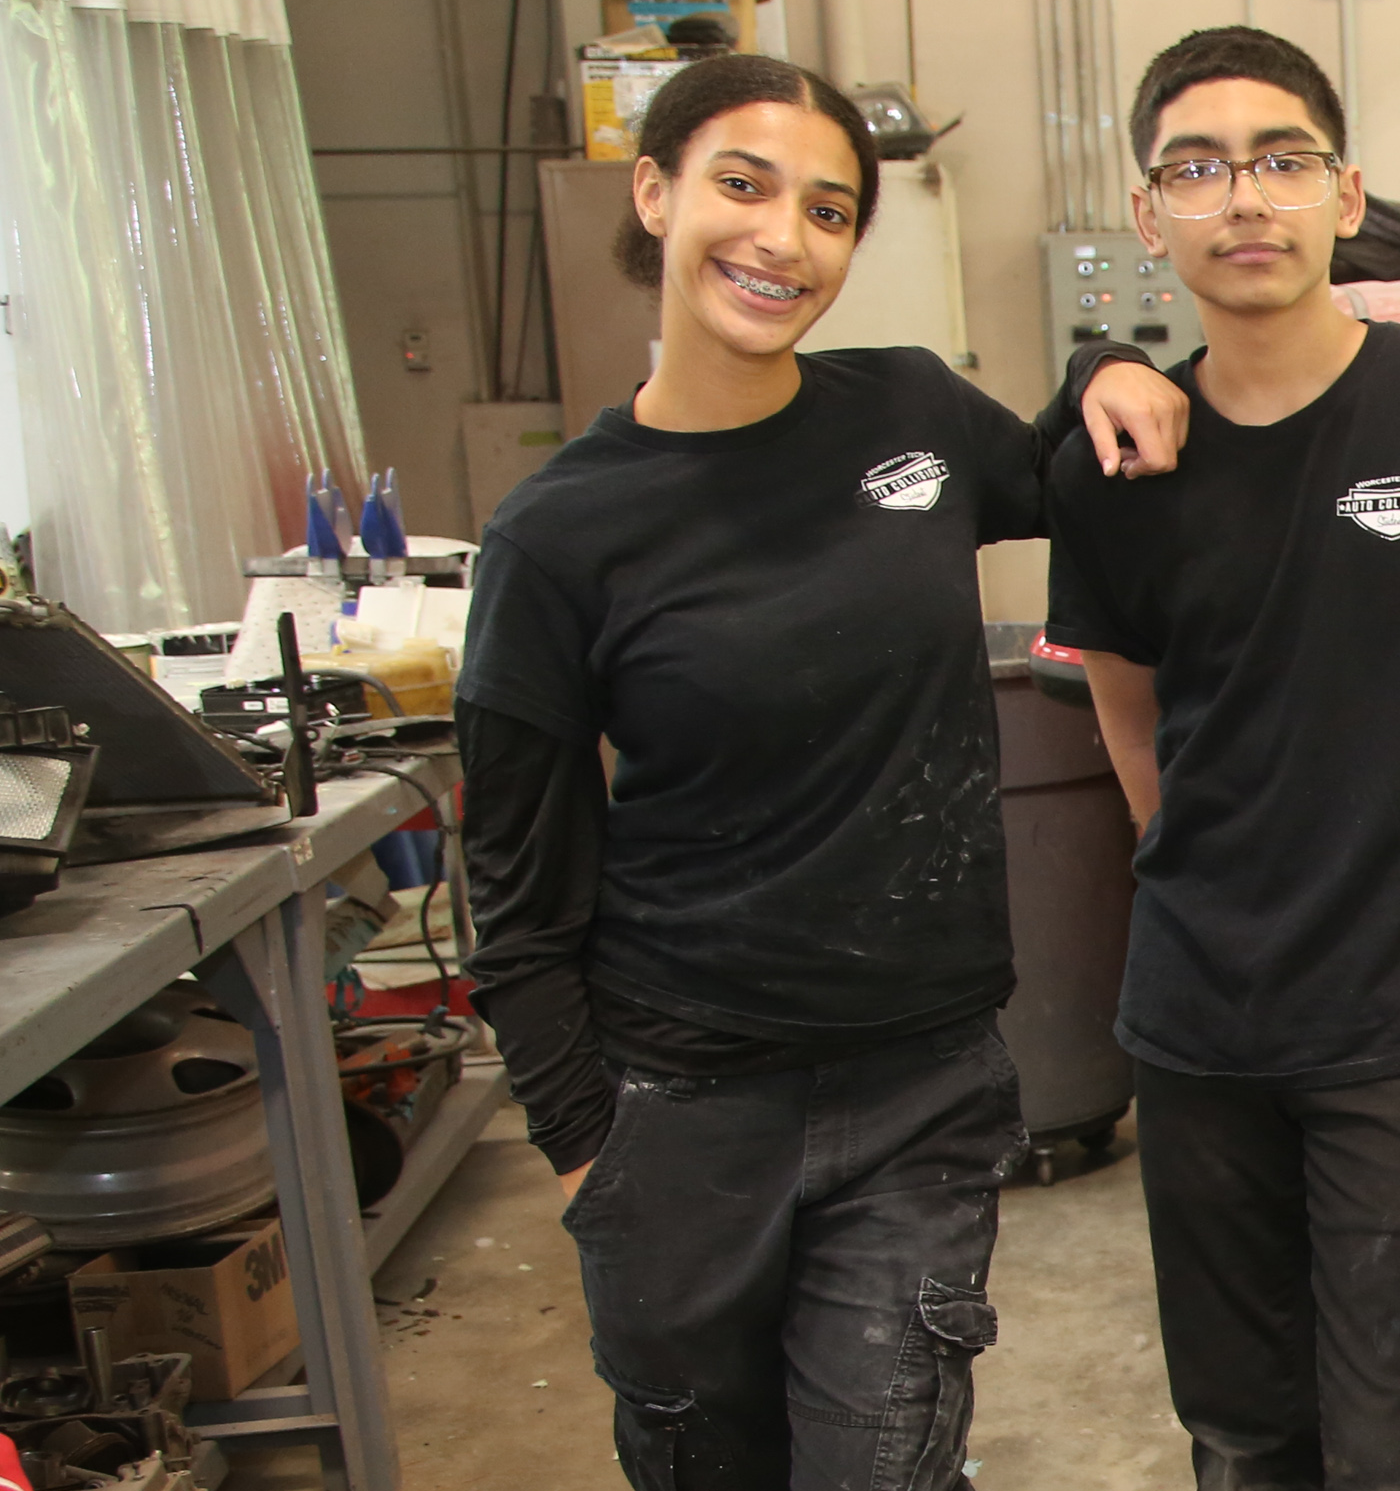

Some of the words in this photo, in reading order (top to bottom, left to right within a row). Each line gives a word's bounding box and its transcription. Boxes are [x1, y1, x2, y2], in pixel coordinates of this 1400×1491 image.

[890, 465, 942, 492] COLLISION
[1345, 499, 1373, 512] AUTO
[245, 1232, 287, 1302] 3M
